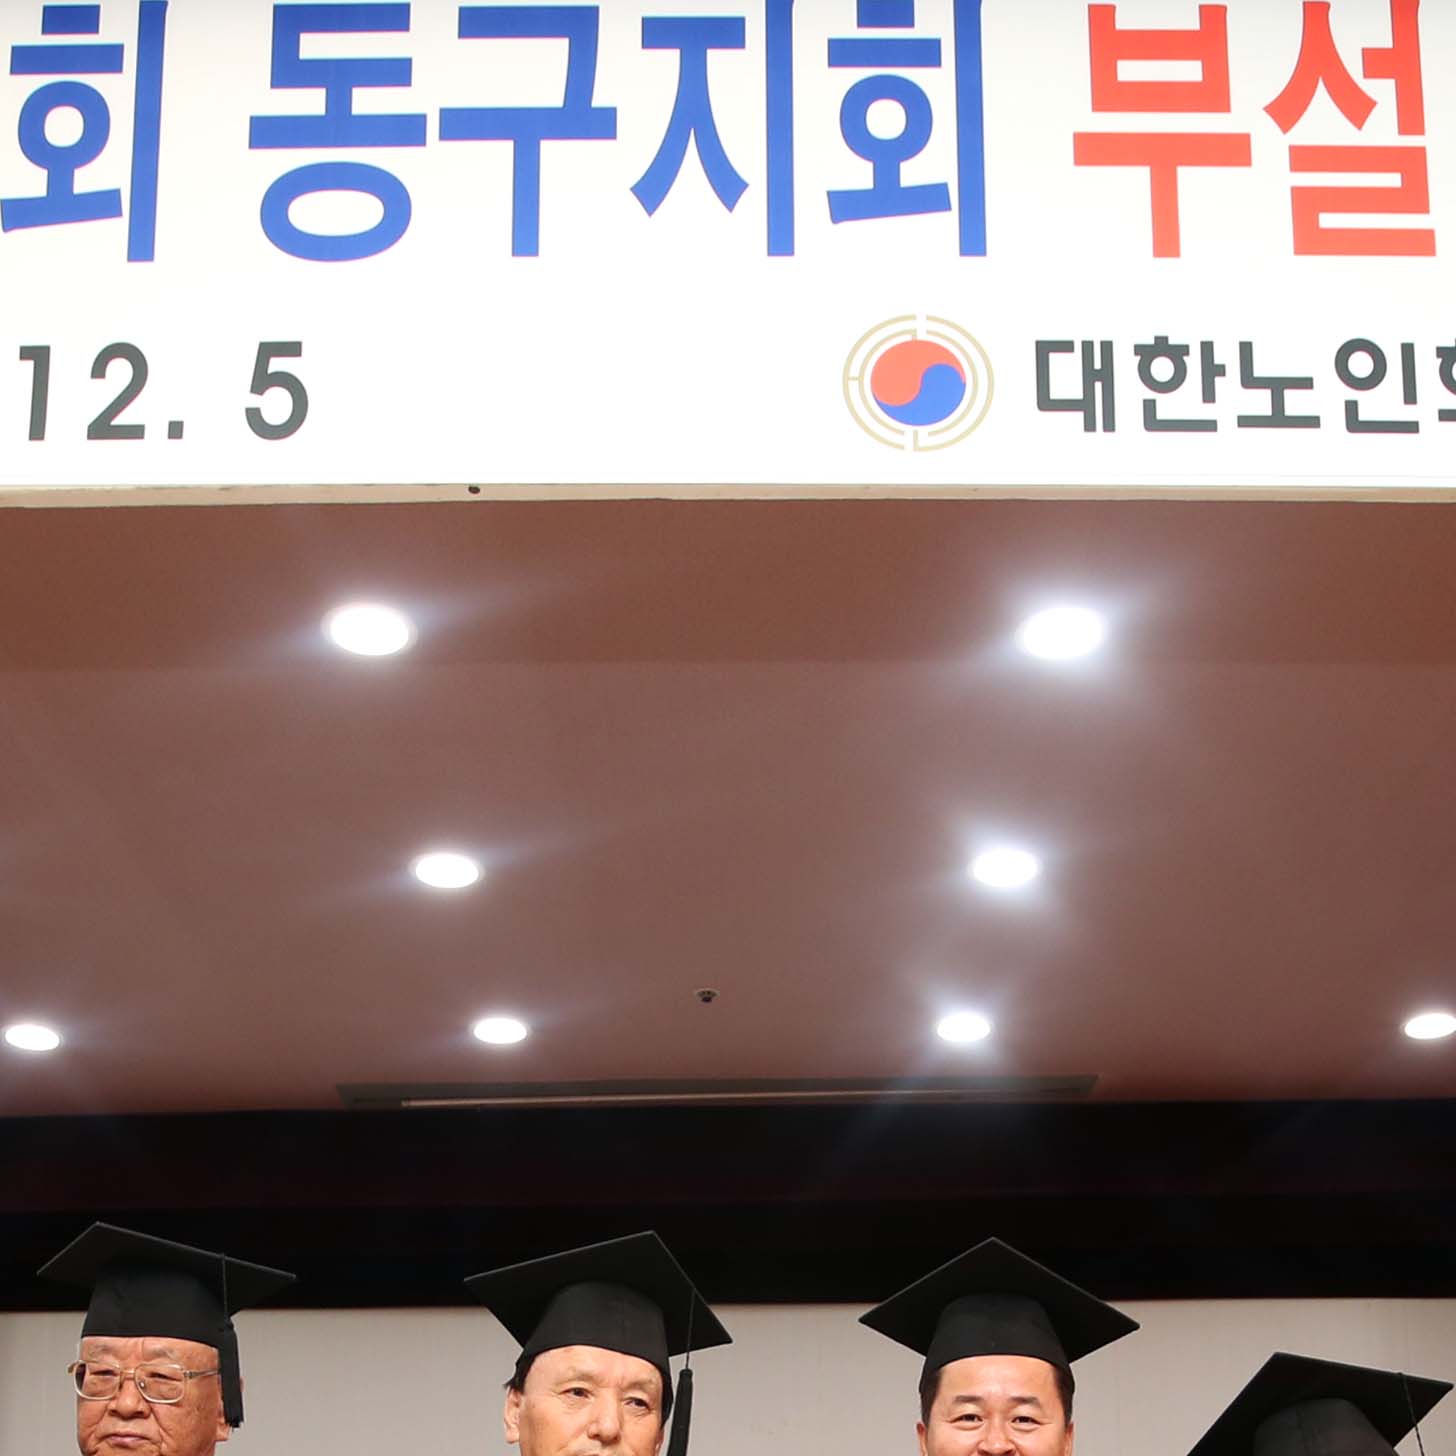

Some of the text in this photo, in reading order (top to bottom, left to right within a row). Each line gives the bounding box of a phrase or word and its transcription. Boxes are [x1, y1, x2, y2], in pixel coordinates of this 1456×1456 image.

[249, 0, 985, 259] 동구지회
[1075, 0, 1434, 256] 부설
[20, 343, 182, 440] 12.
[246, 342, 307, 439] 5
